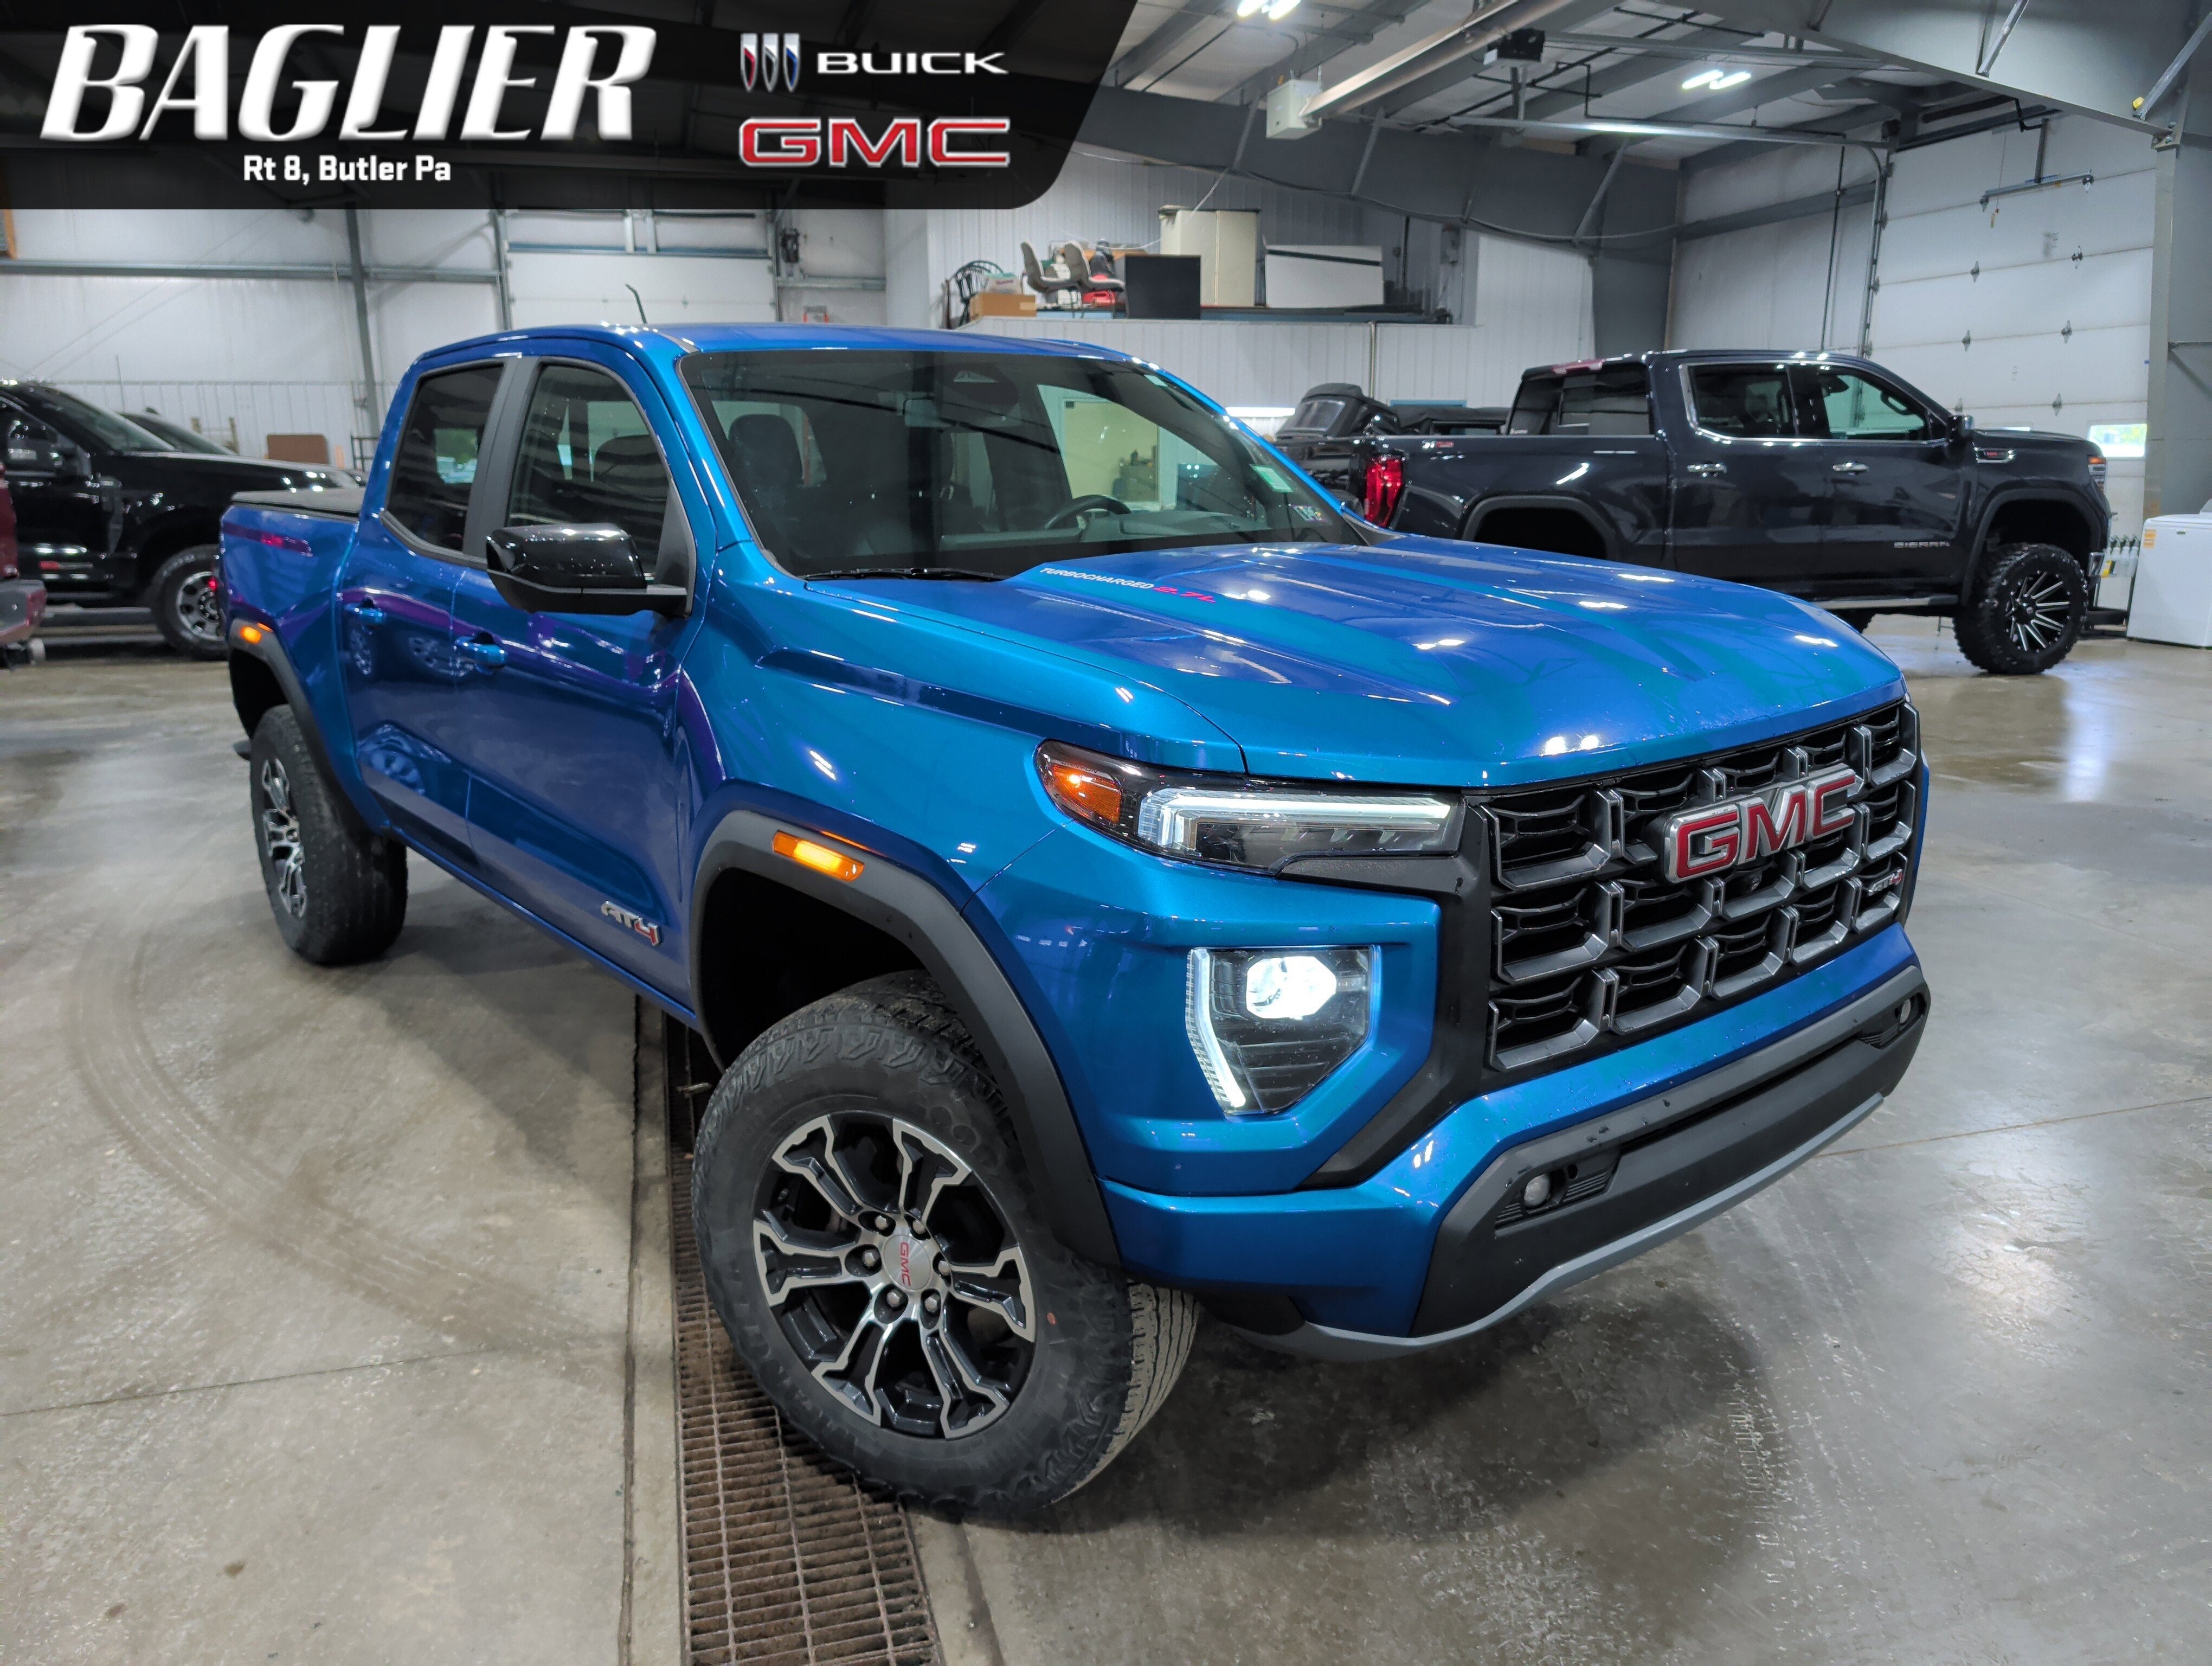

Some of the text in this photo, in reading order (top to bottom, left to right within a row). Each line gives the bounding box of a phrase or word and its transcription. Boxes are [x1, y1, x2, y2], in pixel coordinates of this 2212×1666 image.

[1039, 567, 1155, 589] TURBOCHARGED
[1664, 768, 1856, 884] GMC
[600, 900, 660, 946] AT4
[900, 1241, 912, 1287] GMC
